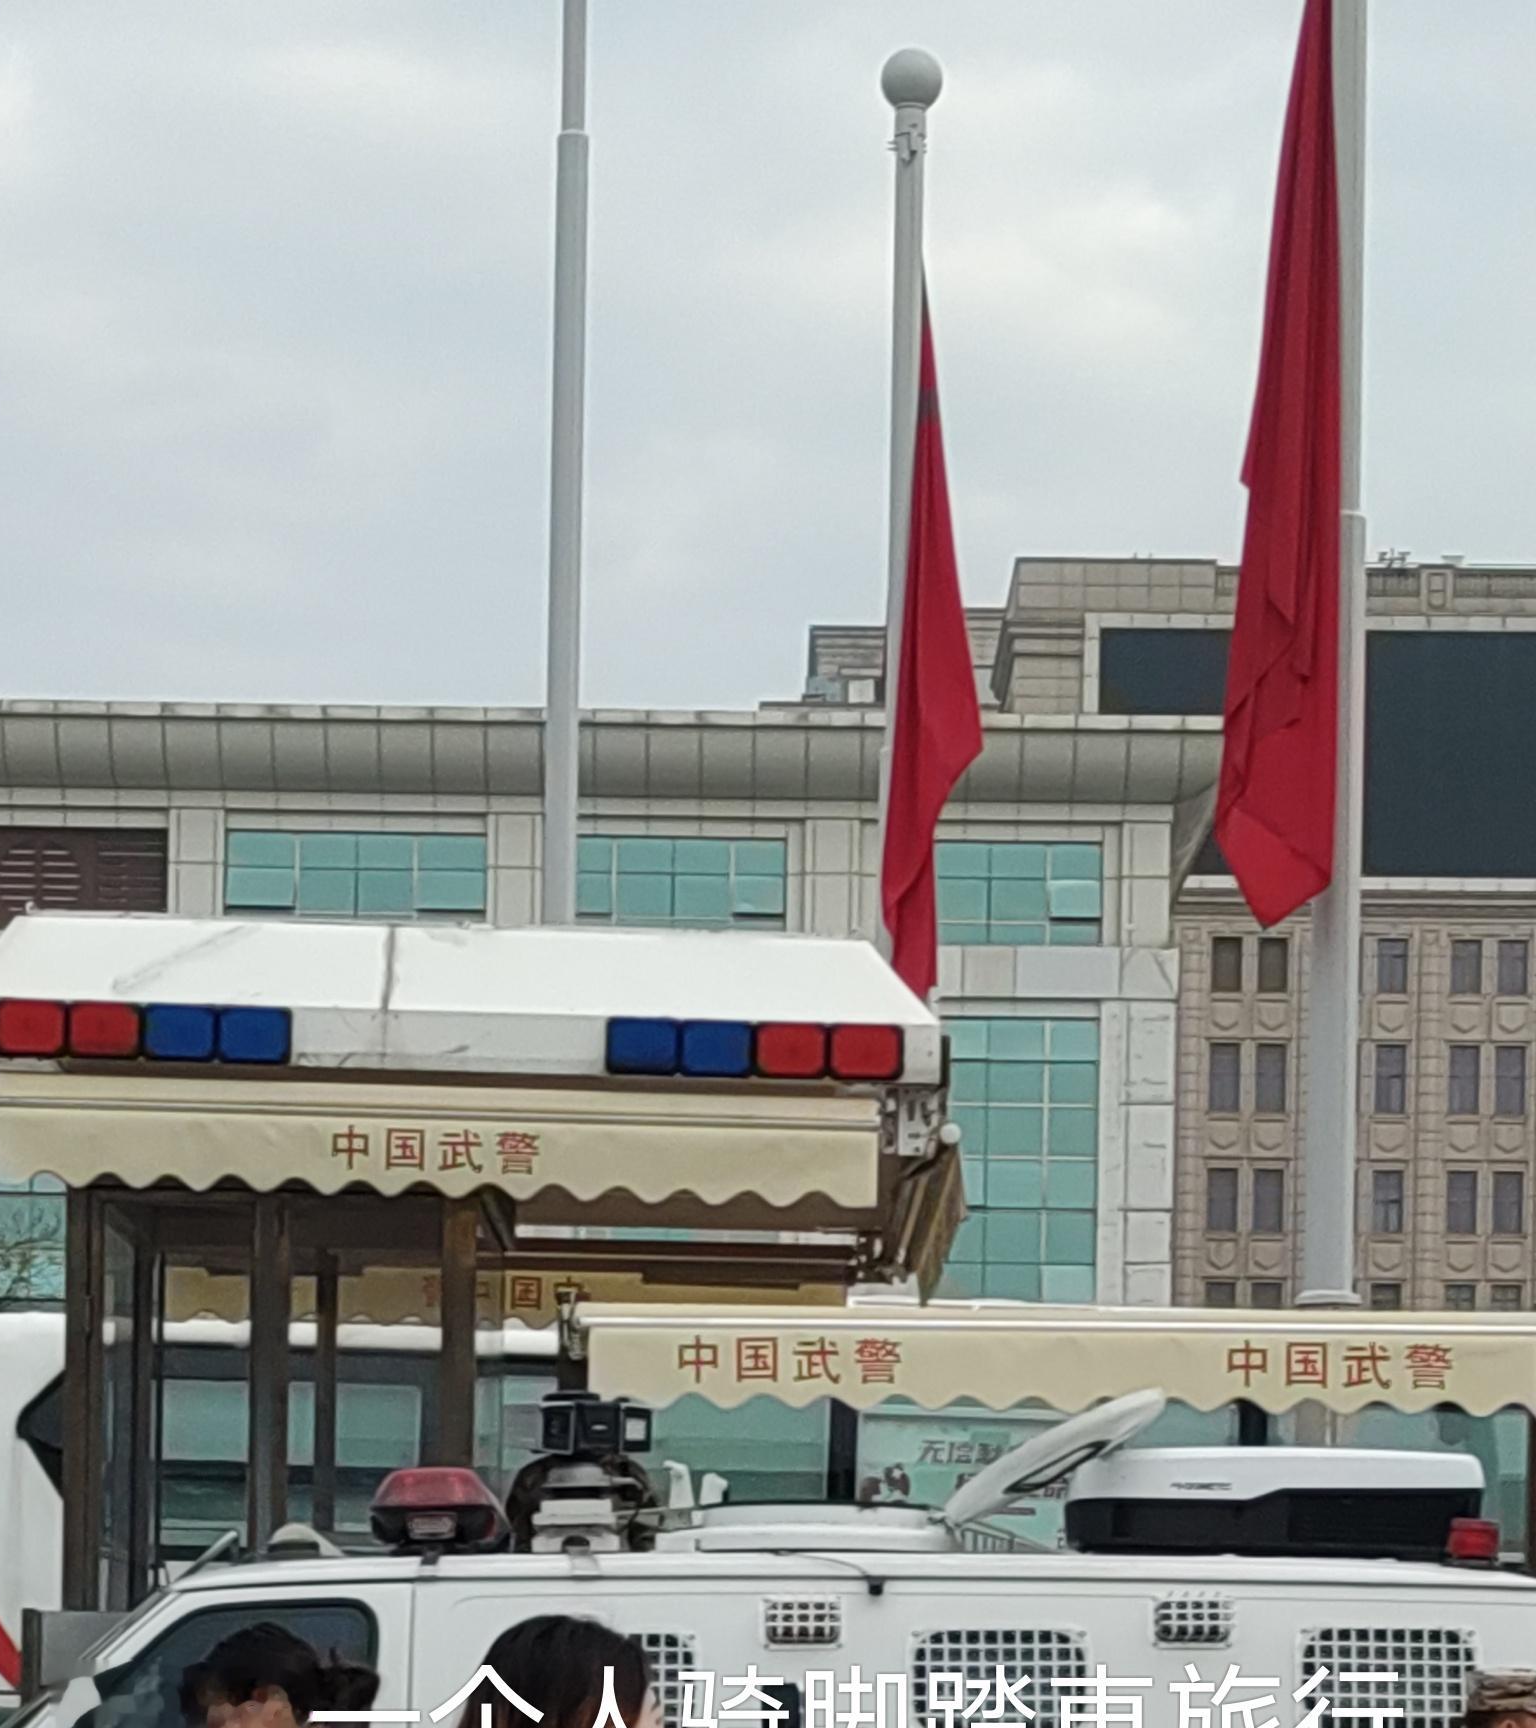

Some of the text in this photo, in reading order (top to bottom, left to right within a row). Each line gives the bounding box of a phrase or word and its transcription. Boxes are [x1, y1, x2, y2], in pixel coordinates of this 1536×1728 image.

[331, 1125, 541, 1176] 中国武警
[677, 1336, 1454, 1391] 中国武警 中国武警
